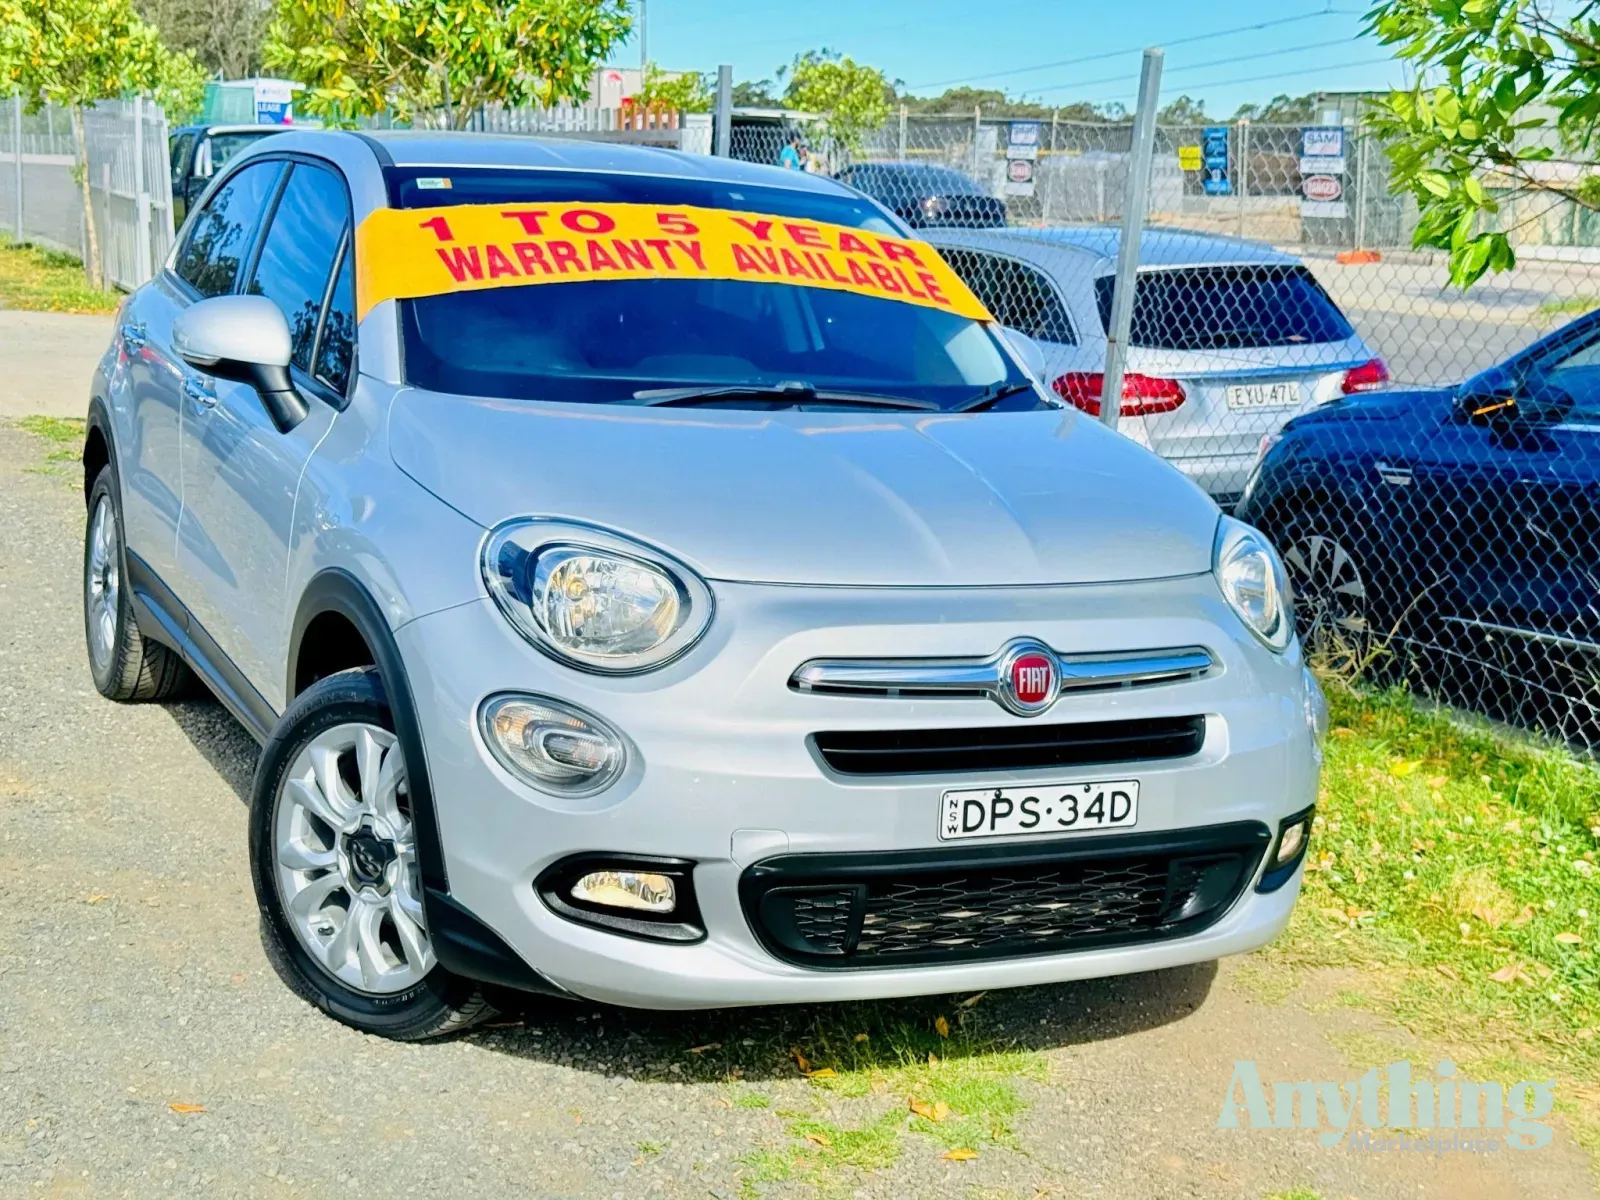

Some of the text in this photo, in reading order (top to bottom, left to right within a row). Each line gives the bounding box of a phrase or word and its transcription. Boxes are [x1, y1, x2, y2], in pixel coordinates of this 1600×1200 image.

[419, 209, 927, 268] 1 TO 5 YEAR
[435, 238, 951, 305] WARRANTY AVAILABLE
[1019, 667, 1048, 693] FIAT
